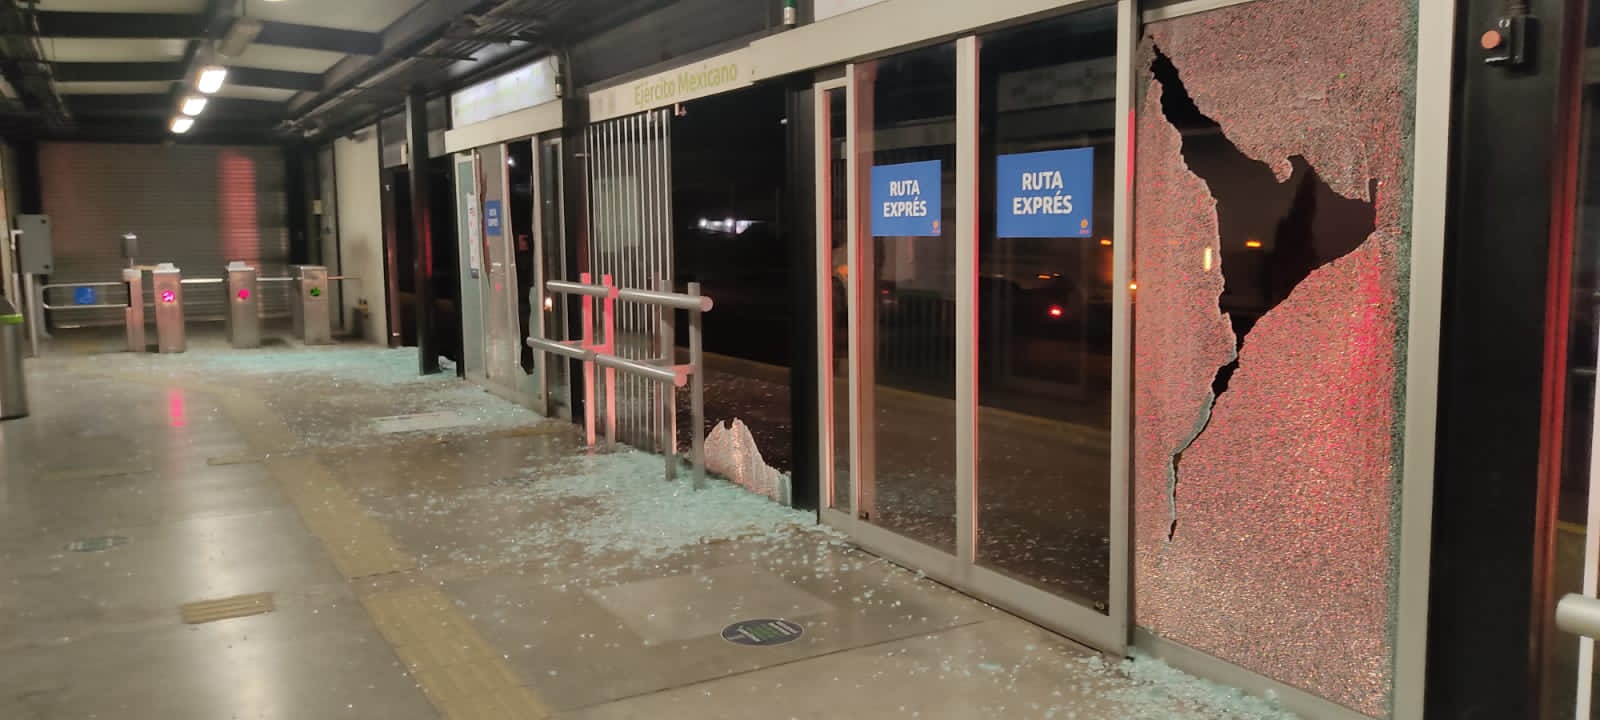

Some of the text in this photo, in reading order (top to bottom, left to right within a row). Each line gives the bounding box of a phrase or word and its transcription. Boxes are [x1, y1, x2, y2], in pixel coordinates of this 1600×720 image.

[677, 63, 737, 95] Mexicano
[889, 179, 920, 197] RUTA
[1021, 170, 1064, 191] RUTA
[882, 196, 928, 217] EXPRÉS
[1012, 189, 1073, 216] EXPRÉS
